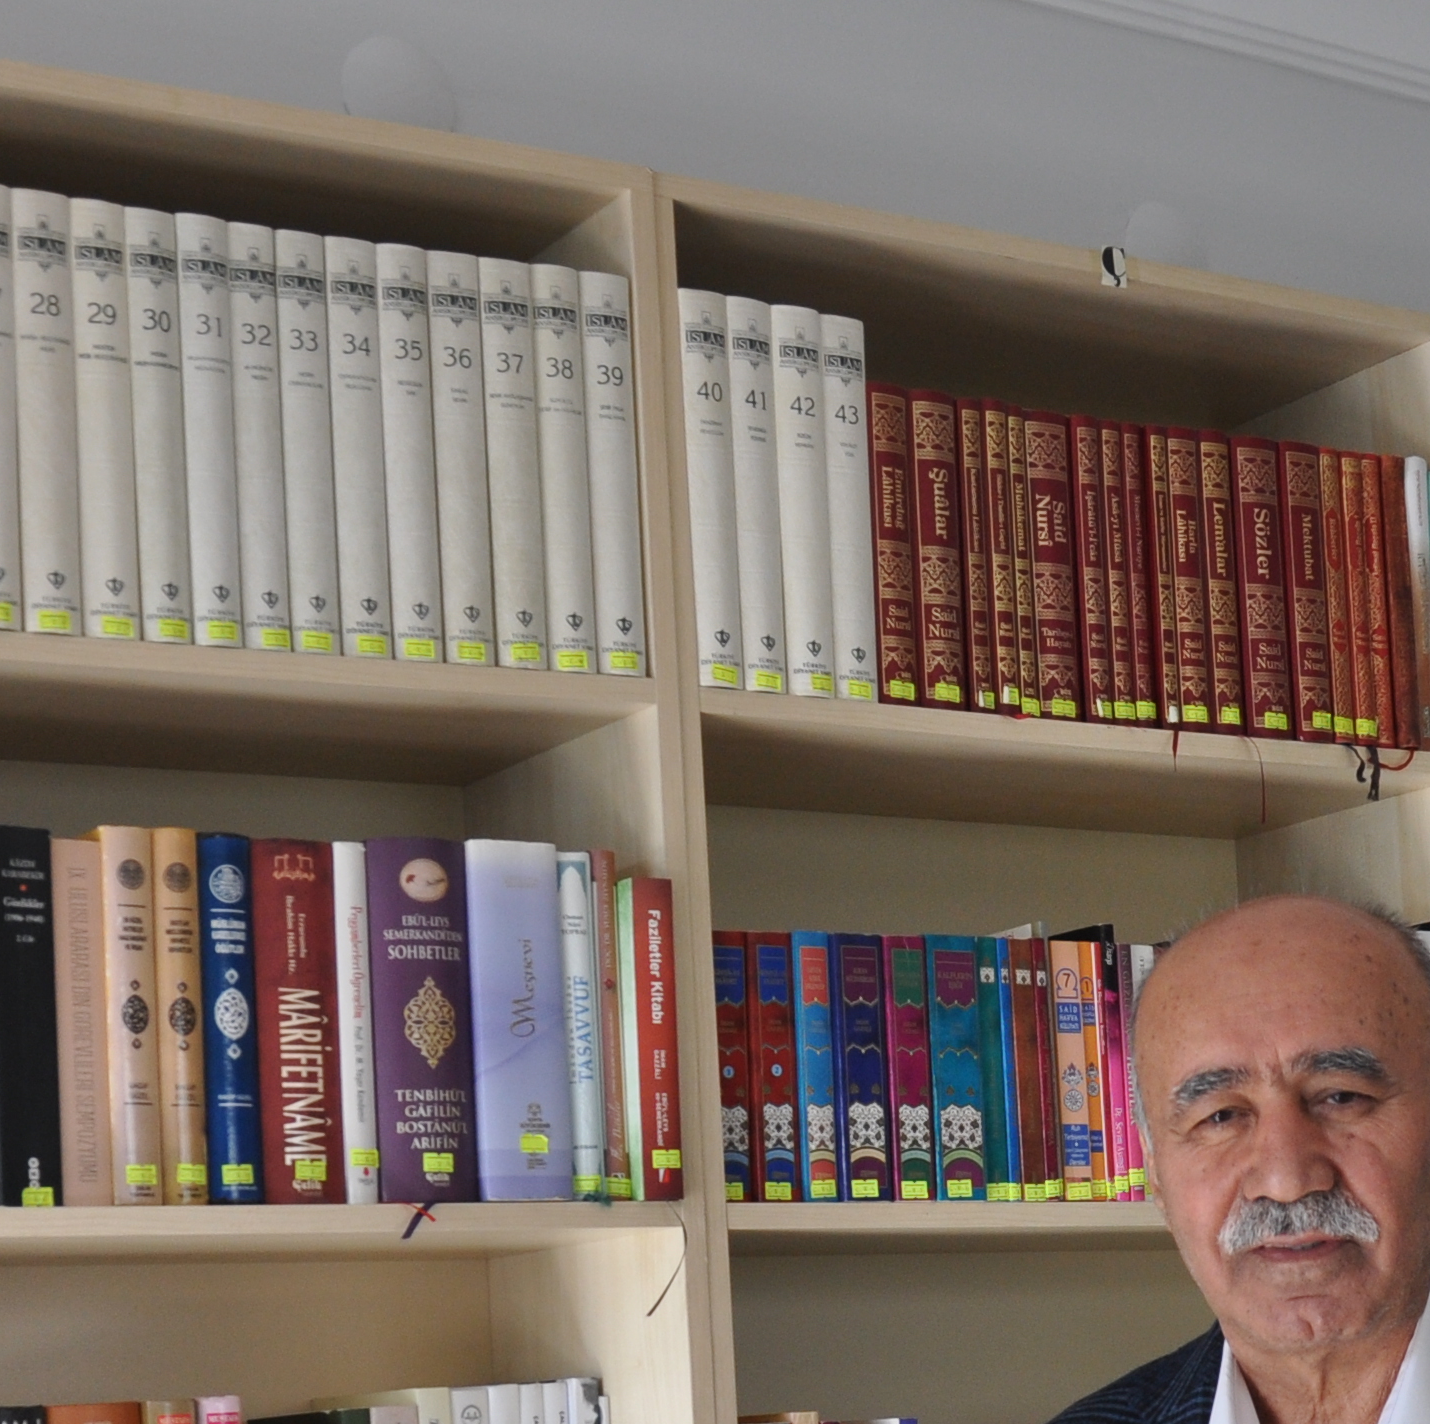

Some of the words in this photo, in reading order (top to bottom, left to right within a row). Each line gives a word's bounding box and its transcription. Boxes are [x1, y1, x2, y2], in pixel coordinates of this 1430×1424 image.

[597, 364, 625, 387] 39
[697, 381, 724, 403] 40
[745, 389, 767, 411] 41
[790, 396, 816, 418] 42
[834, 404, 860, 426] 43
[1254, 508, 1272, 579] Sözler
[1301, 513, 1314, 581] Mektubat
[387, 945, 461, 961] SOHBETLER
[649, 909, 660, 978] Faziletler
[1061, 972, 1071, 988] 7
[573, 975, 593, 1082] TASAVVUF
